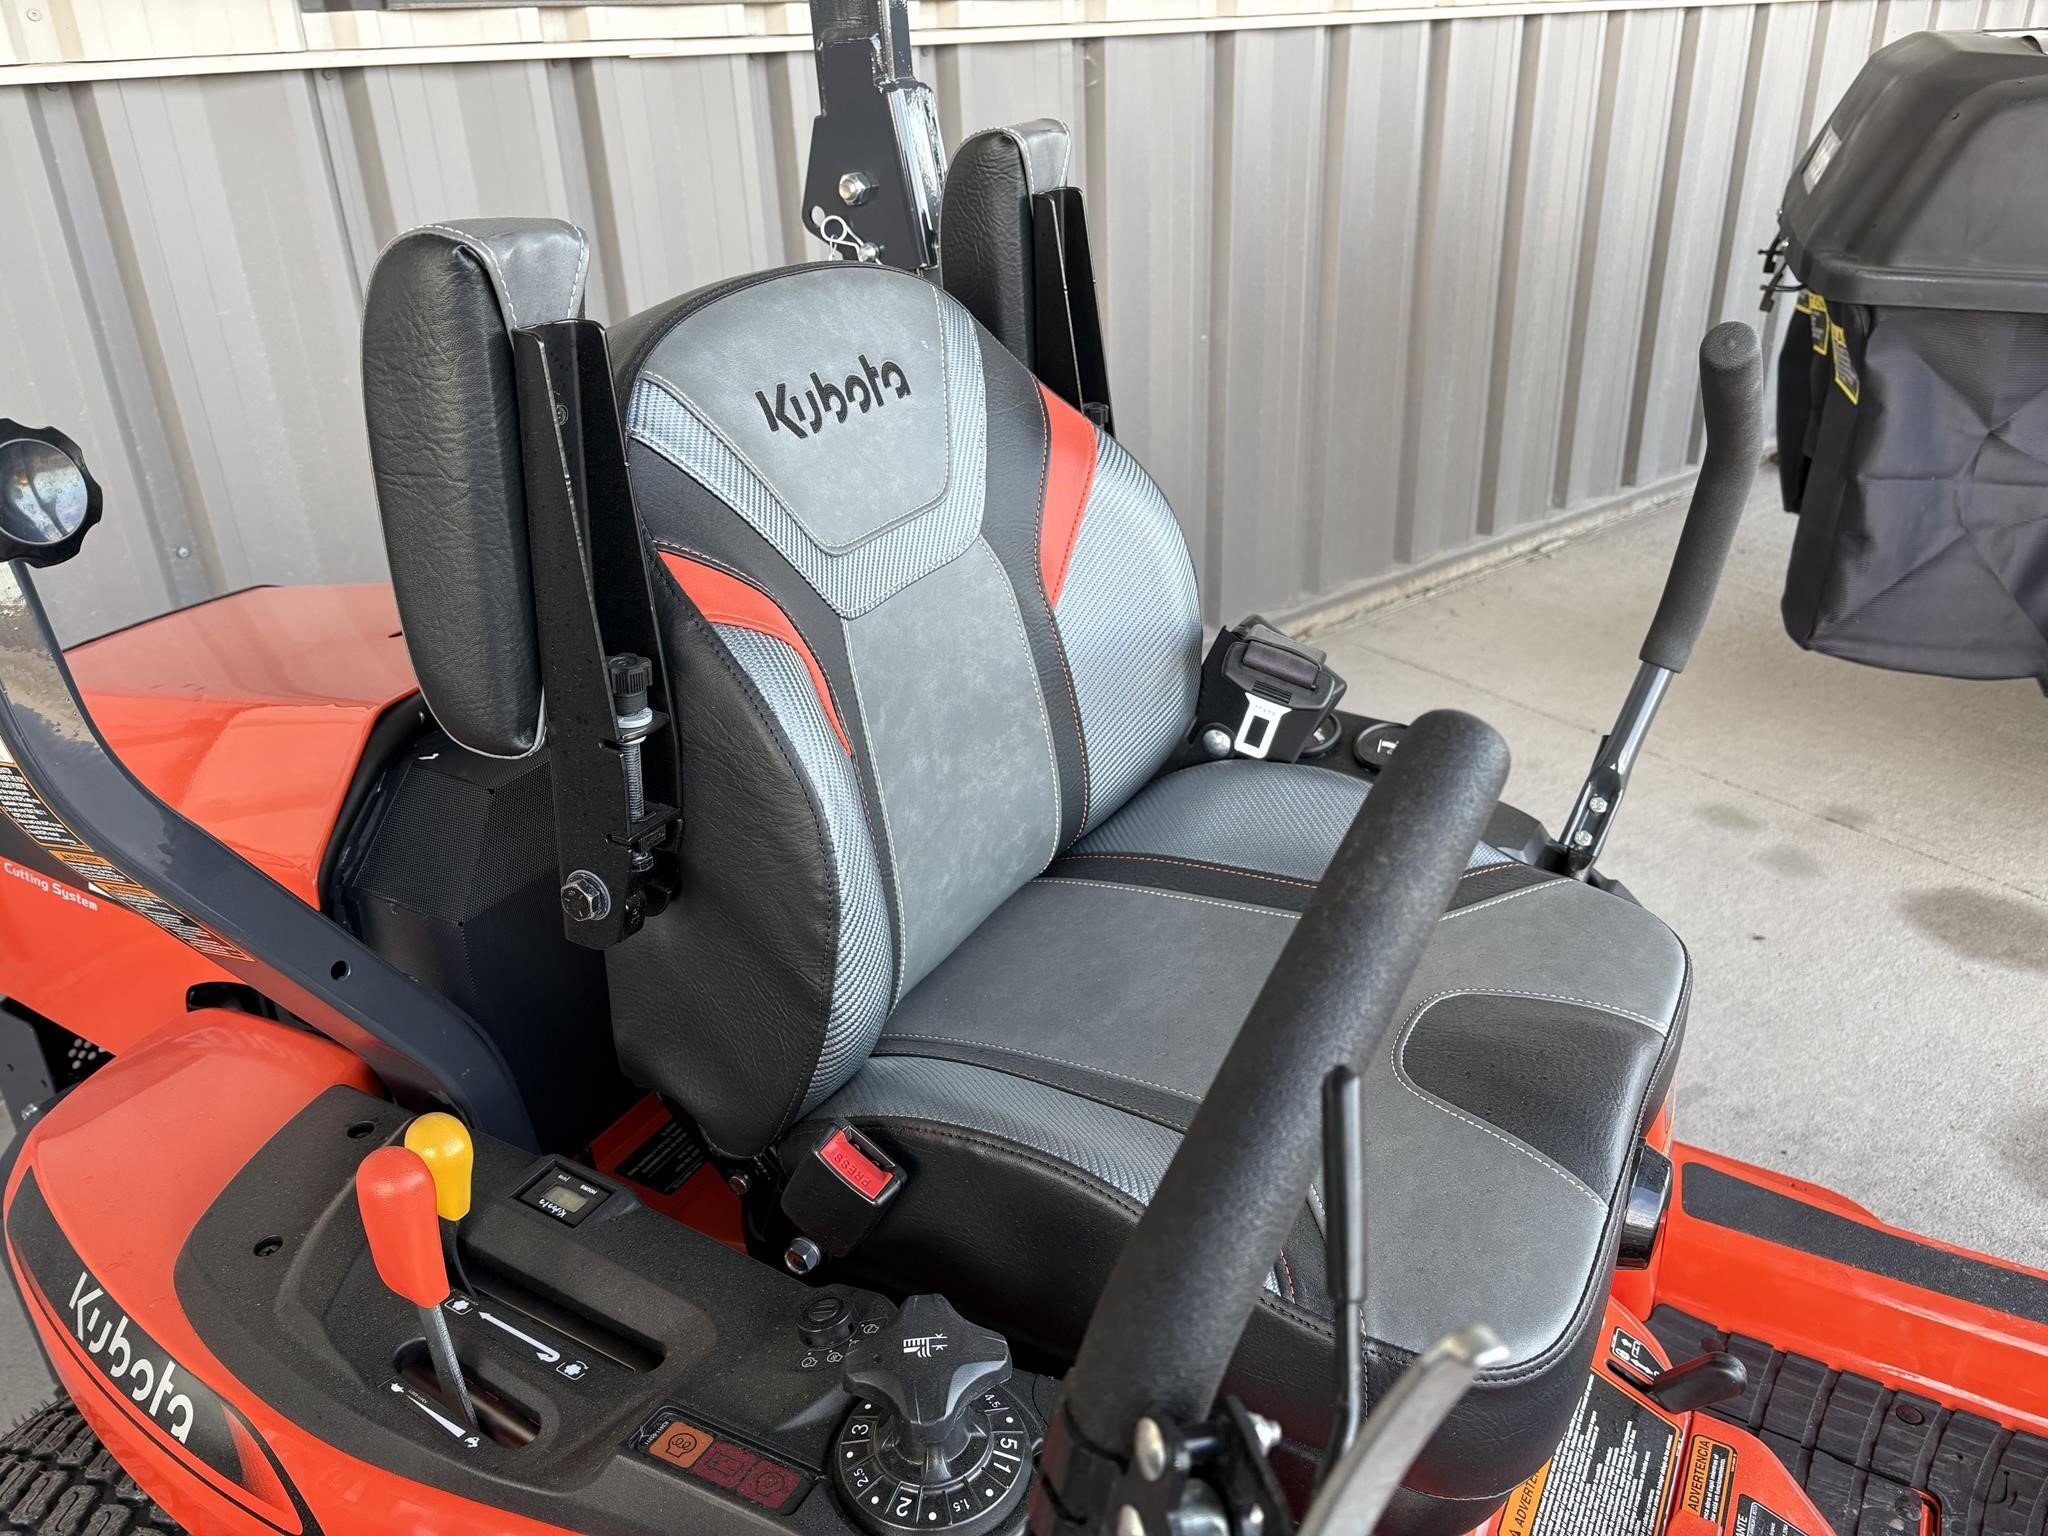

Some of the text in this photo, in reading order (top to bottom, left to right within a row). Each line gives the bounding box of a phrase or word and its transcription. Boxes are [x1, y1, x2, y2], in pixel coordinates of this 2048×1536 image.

[755, 354, 911, 439] Kubota
[4, 862, 49, 892] Cutting
[52, 882, 98, 911] System
[834, 1153, 871, 1187] PRESS
[539, 1198, 567, 1218] Kubota
[68, 1271, 194, 1444] Kubota
[851, 1424, 869, 1435] 3
[1000, 1437, 1018, 1449] 5
[853, 1468, 869, 1487] 2.5
[993, 1462, 1011, 1474] 1
[1690, 1440, 1710, 1512] ADVERTENCIA
[896, 1497, 912, 1517] 2
[953, 1498, 971, 1512] 1.5
